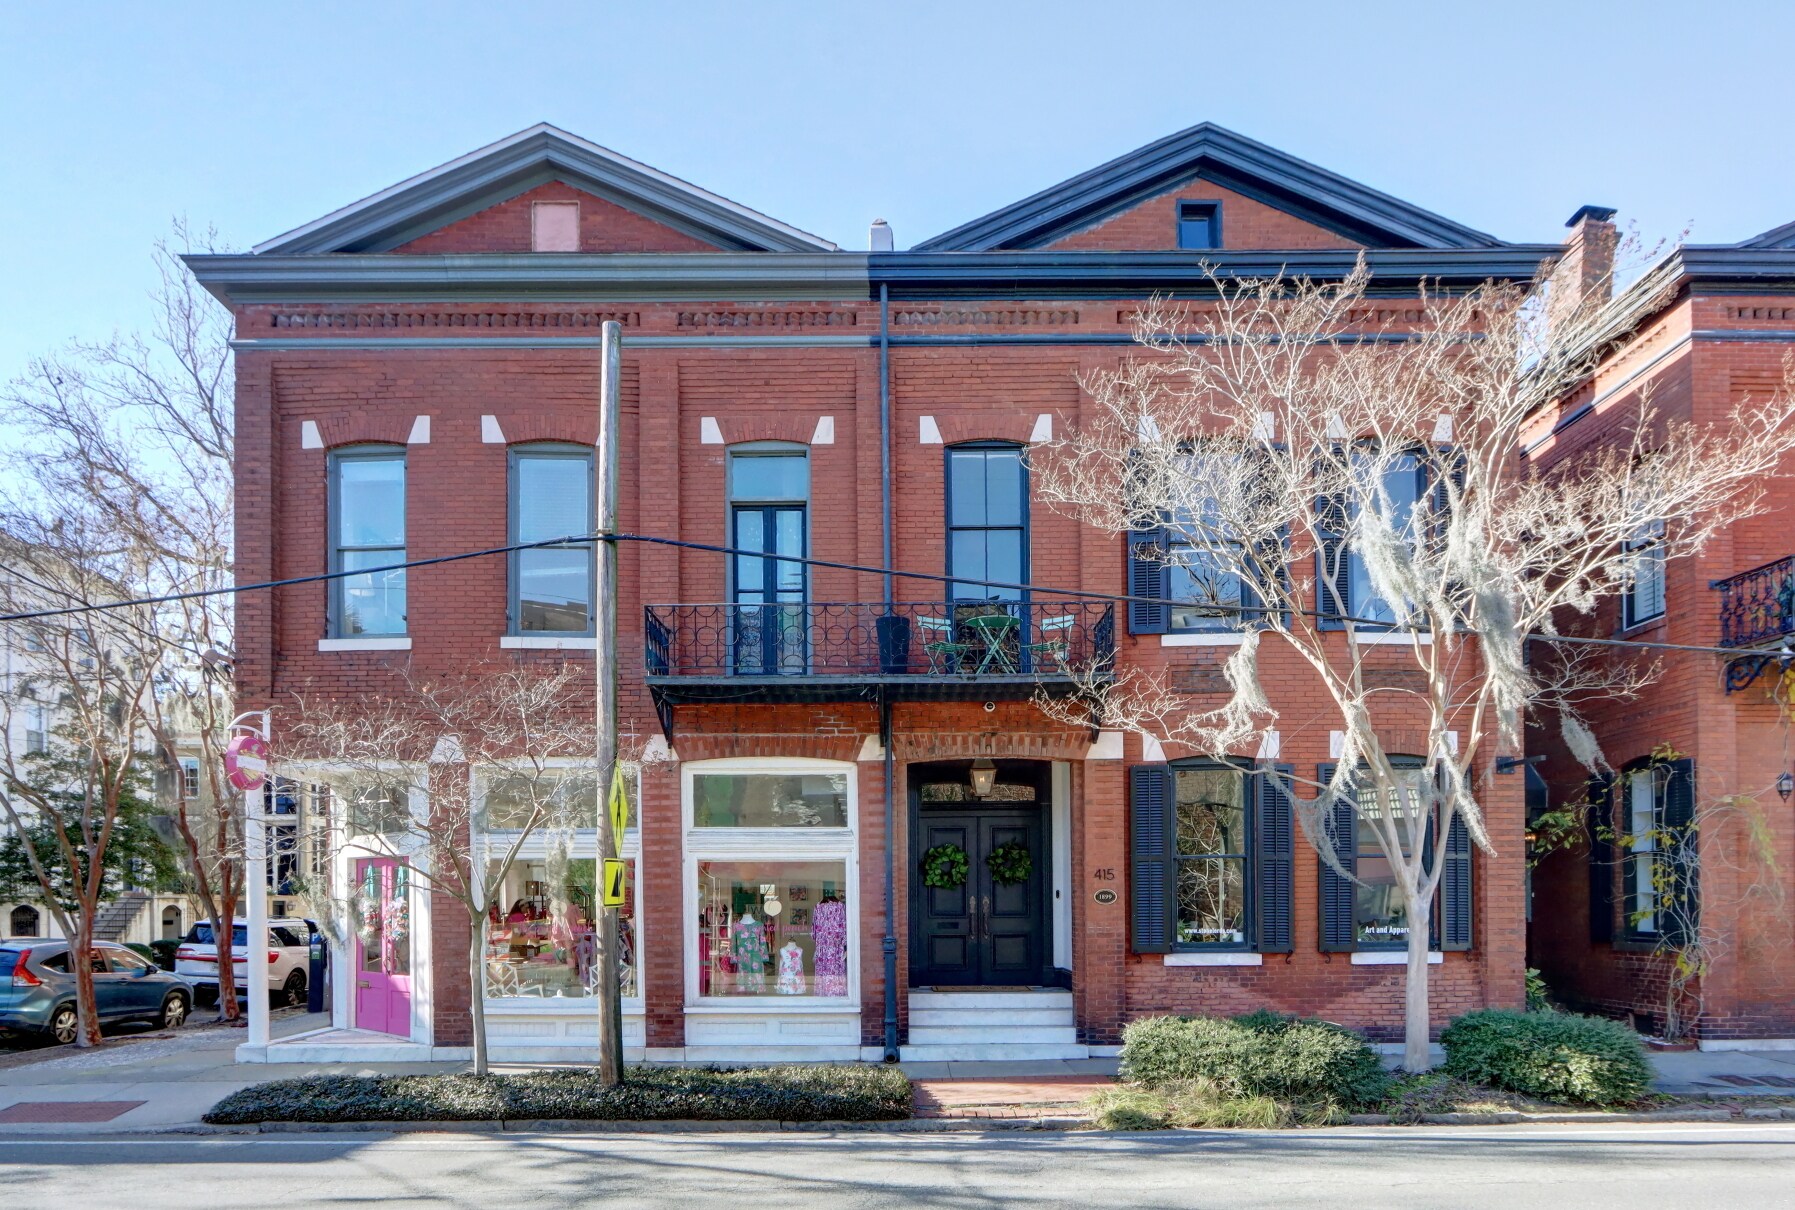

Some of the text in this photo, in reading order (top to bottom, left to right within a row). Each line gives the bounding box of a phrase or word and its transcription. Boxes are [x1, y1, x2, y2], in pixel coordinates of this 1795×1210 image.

[1094, 868, 1115, 881] 415
[1365, 926, 1410, 935] Art and Appare
[311, 933, 318, 942] P
